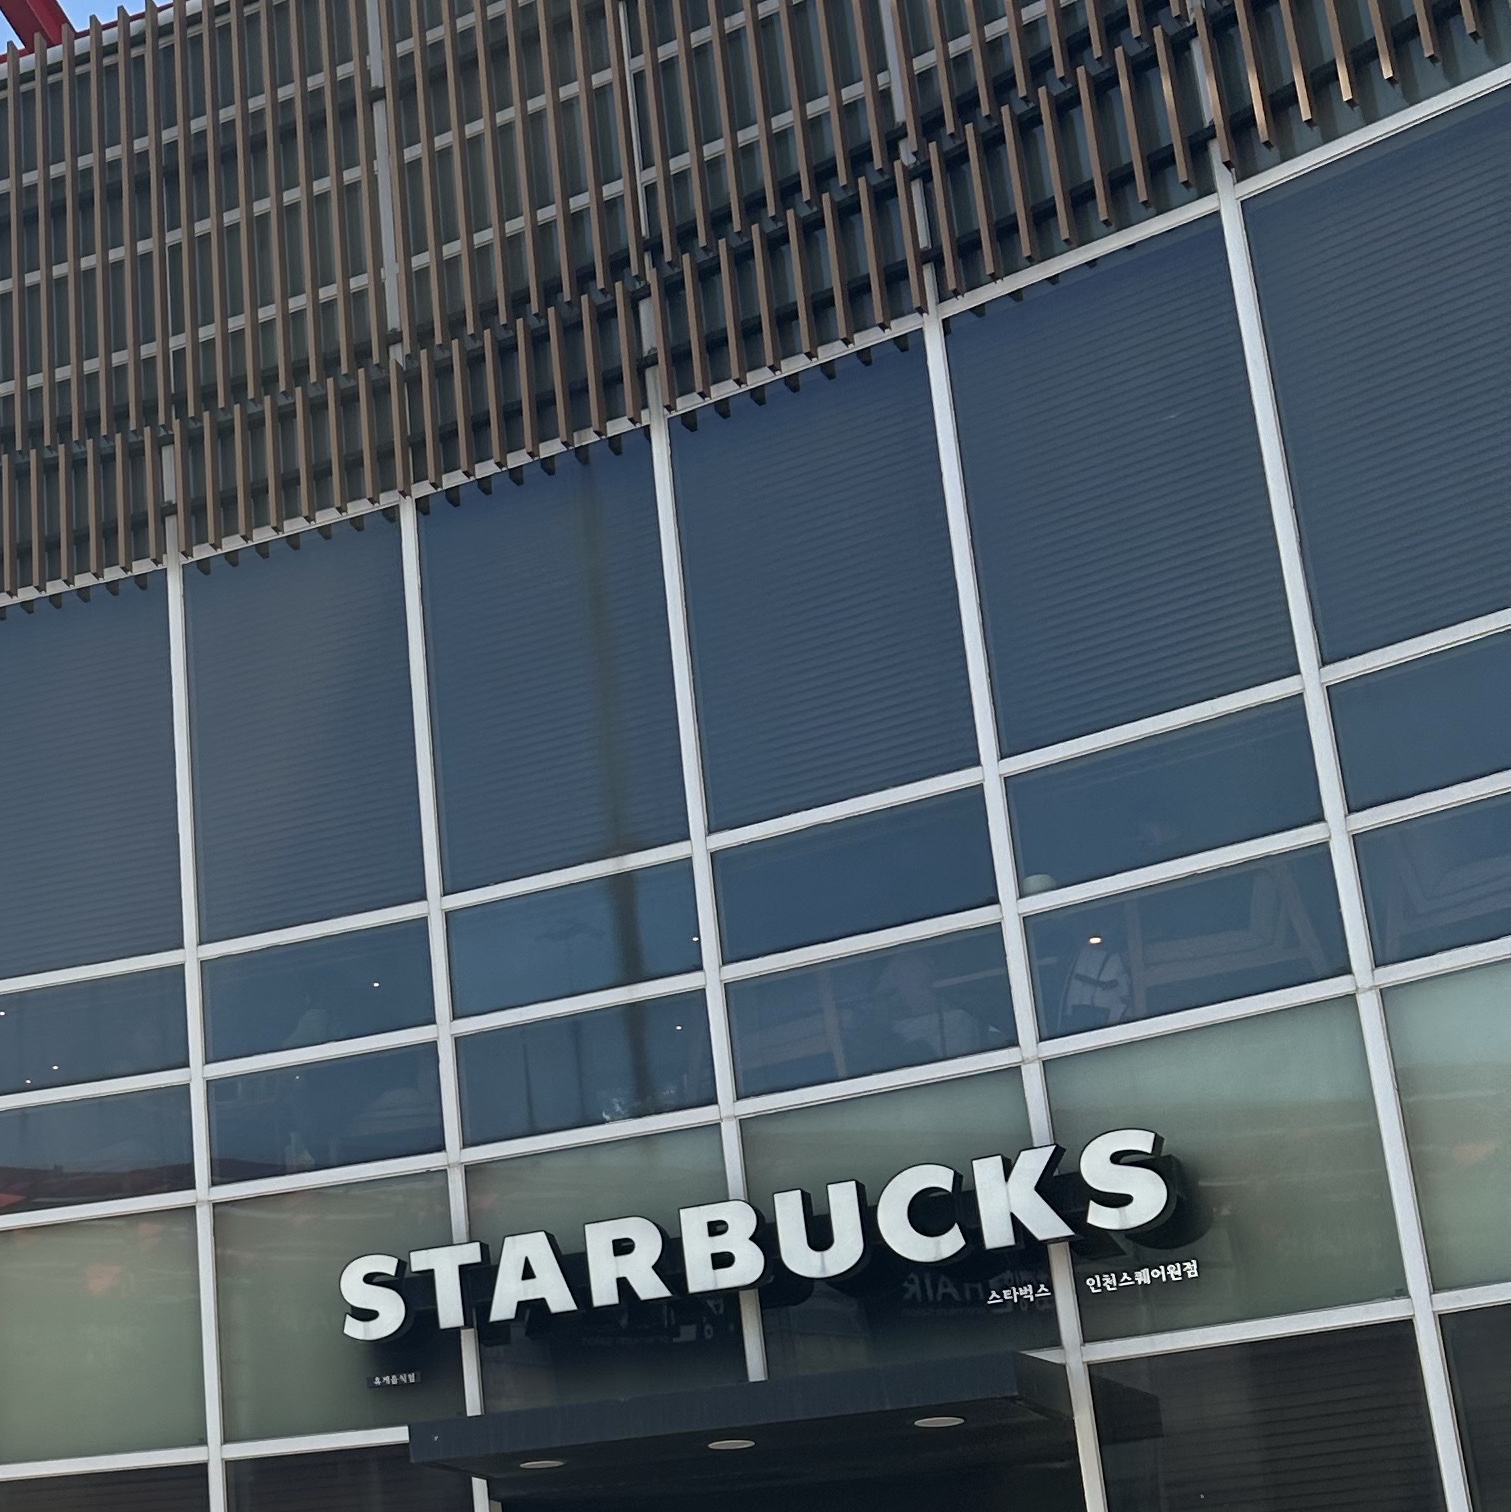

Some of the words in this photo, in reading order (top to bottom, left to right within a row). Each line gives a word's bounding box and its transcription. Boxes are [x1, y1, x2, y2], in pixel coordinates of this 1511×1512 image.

[338, 1128, 1175, 1342] STARBUCKS
[987, 1282, 1052, 1304] 스타벅스
[1086, 1259, 1199, 1293] 인천스퀘어원점
